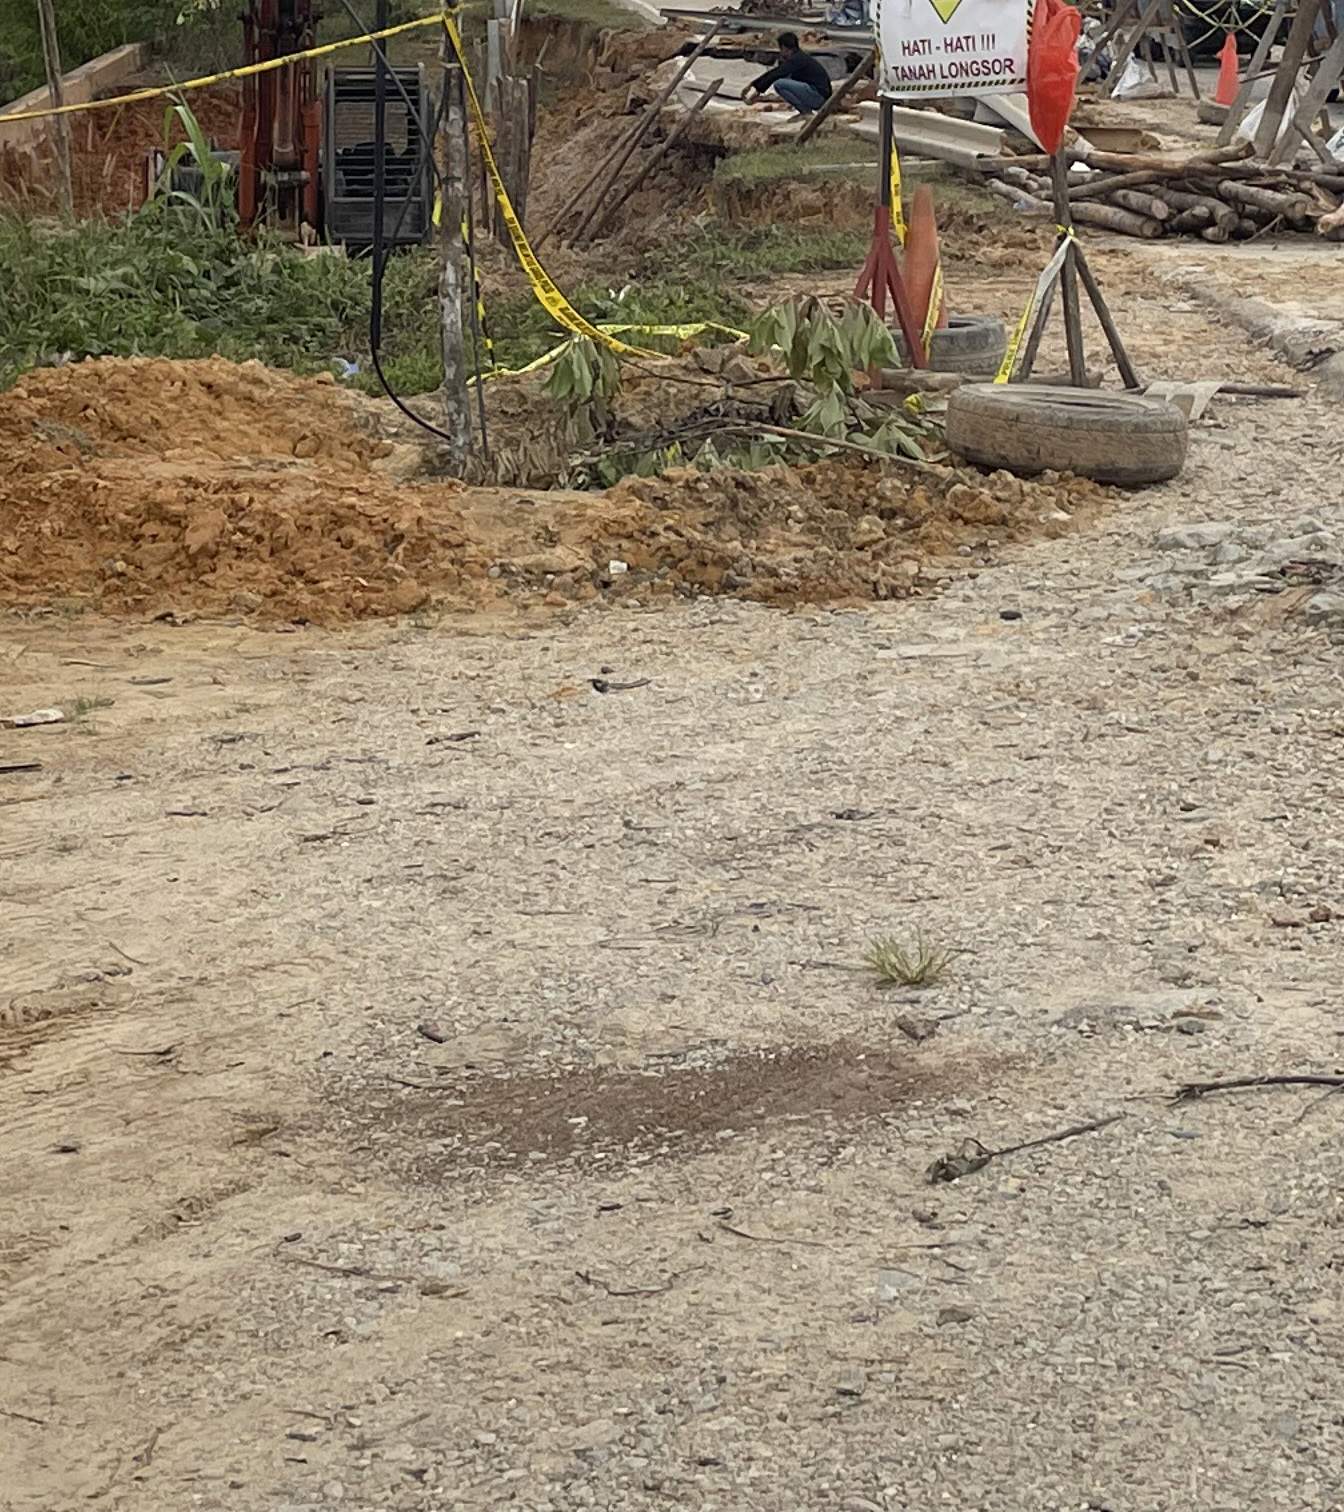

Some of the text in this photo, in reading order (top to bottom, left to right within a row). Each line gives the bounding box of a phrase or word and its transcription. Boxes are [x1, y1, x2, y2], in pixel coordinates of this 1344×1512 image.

[901, 38, 932, 56] HATI
[944, 35, 976, 53] HATI
[892, 58, 1016, 81] TANAH LONGSOR
